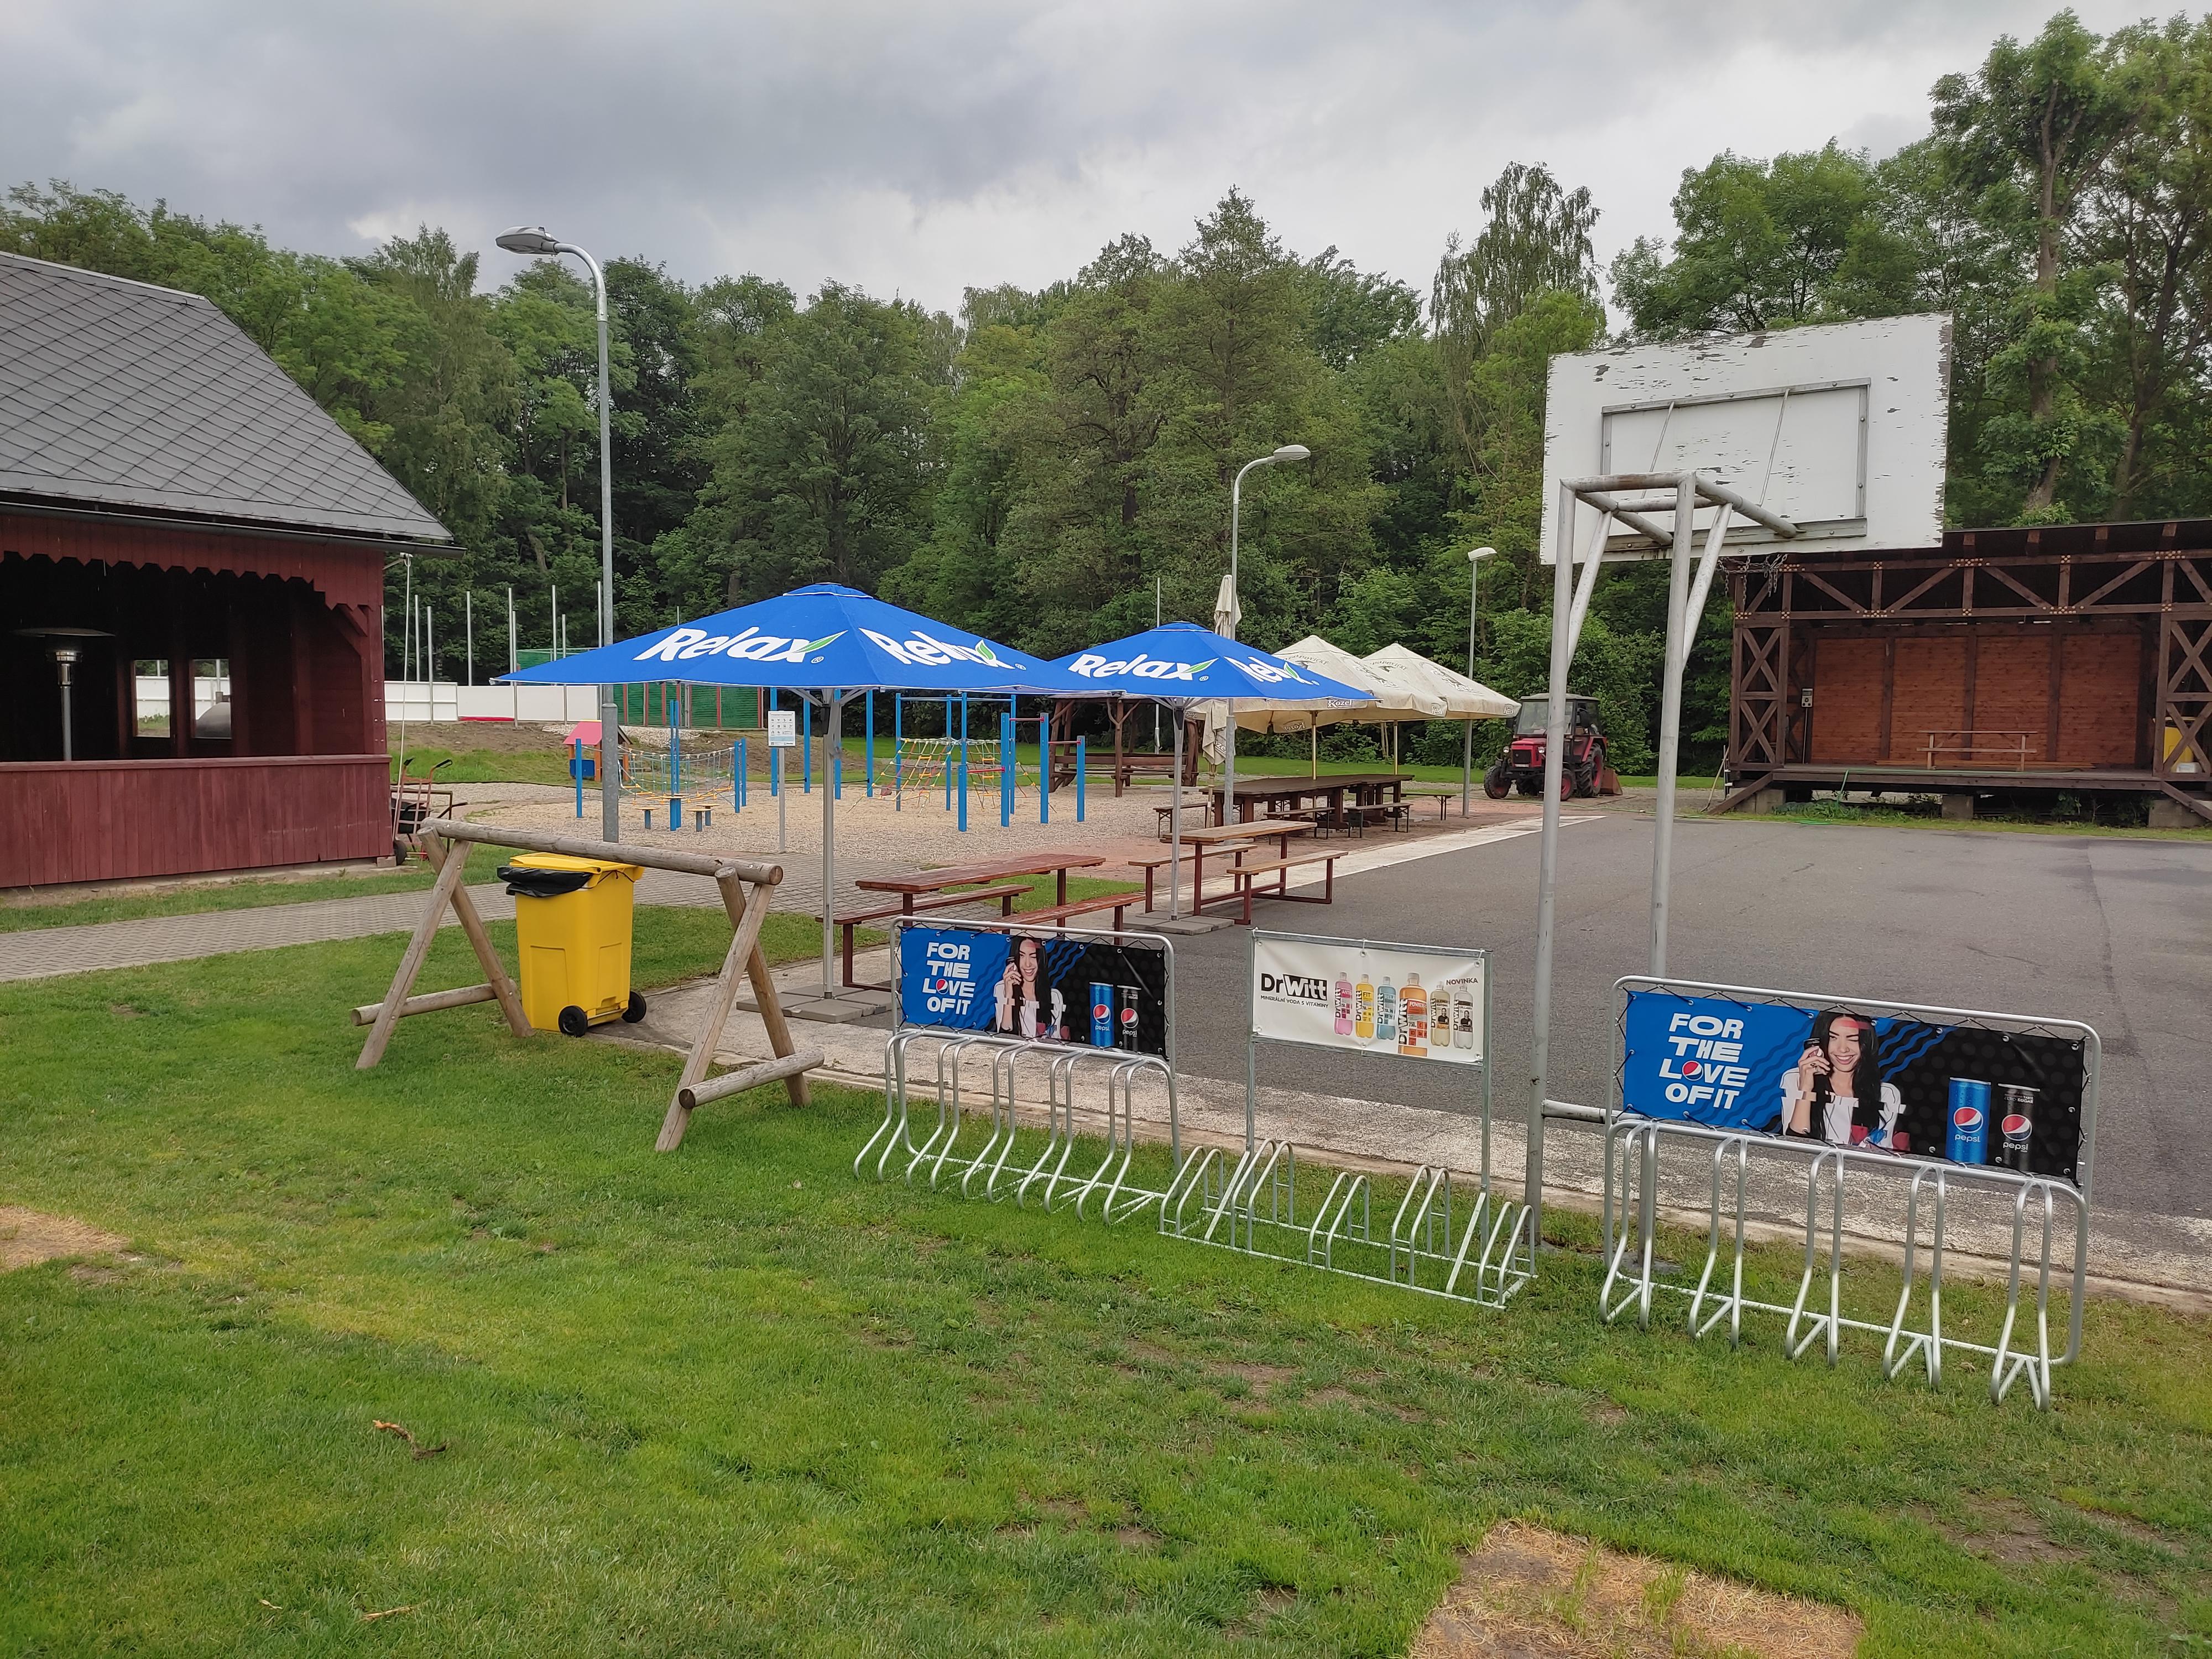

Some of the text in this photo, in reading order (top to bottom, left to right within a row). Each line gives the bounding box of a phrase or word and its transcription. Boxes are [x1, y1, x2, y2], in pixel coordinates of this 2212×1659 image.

[632, 627, 848, 663] Relax
[1068, 654, 1218, 681] Relax
[1327, 699, 1353, 708] Kozel
[926, 942, 971, 961] FOR
[926, 960, 971, 979] THE
[1261, 973, 1327, 1001] DrWitt
[1669, 1013, 1744, 1039] FOR
[1668, 1036, 1743, 1063] THE
[1954, 1134, 1980, 1143] pepsi
[2002, 1141, 2028, 1151] pepsi
